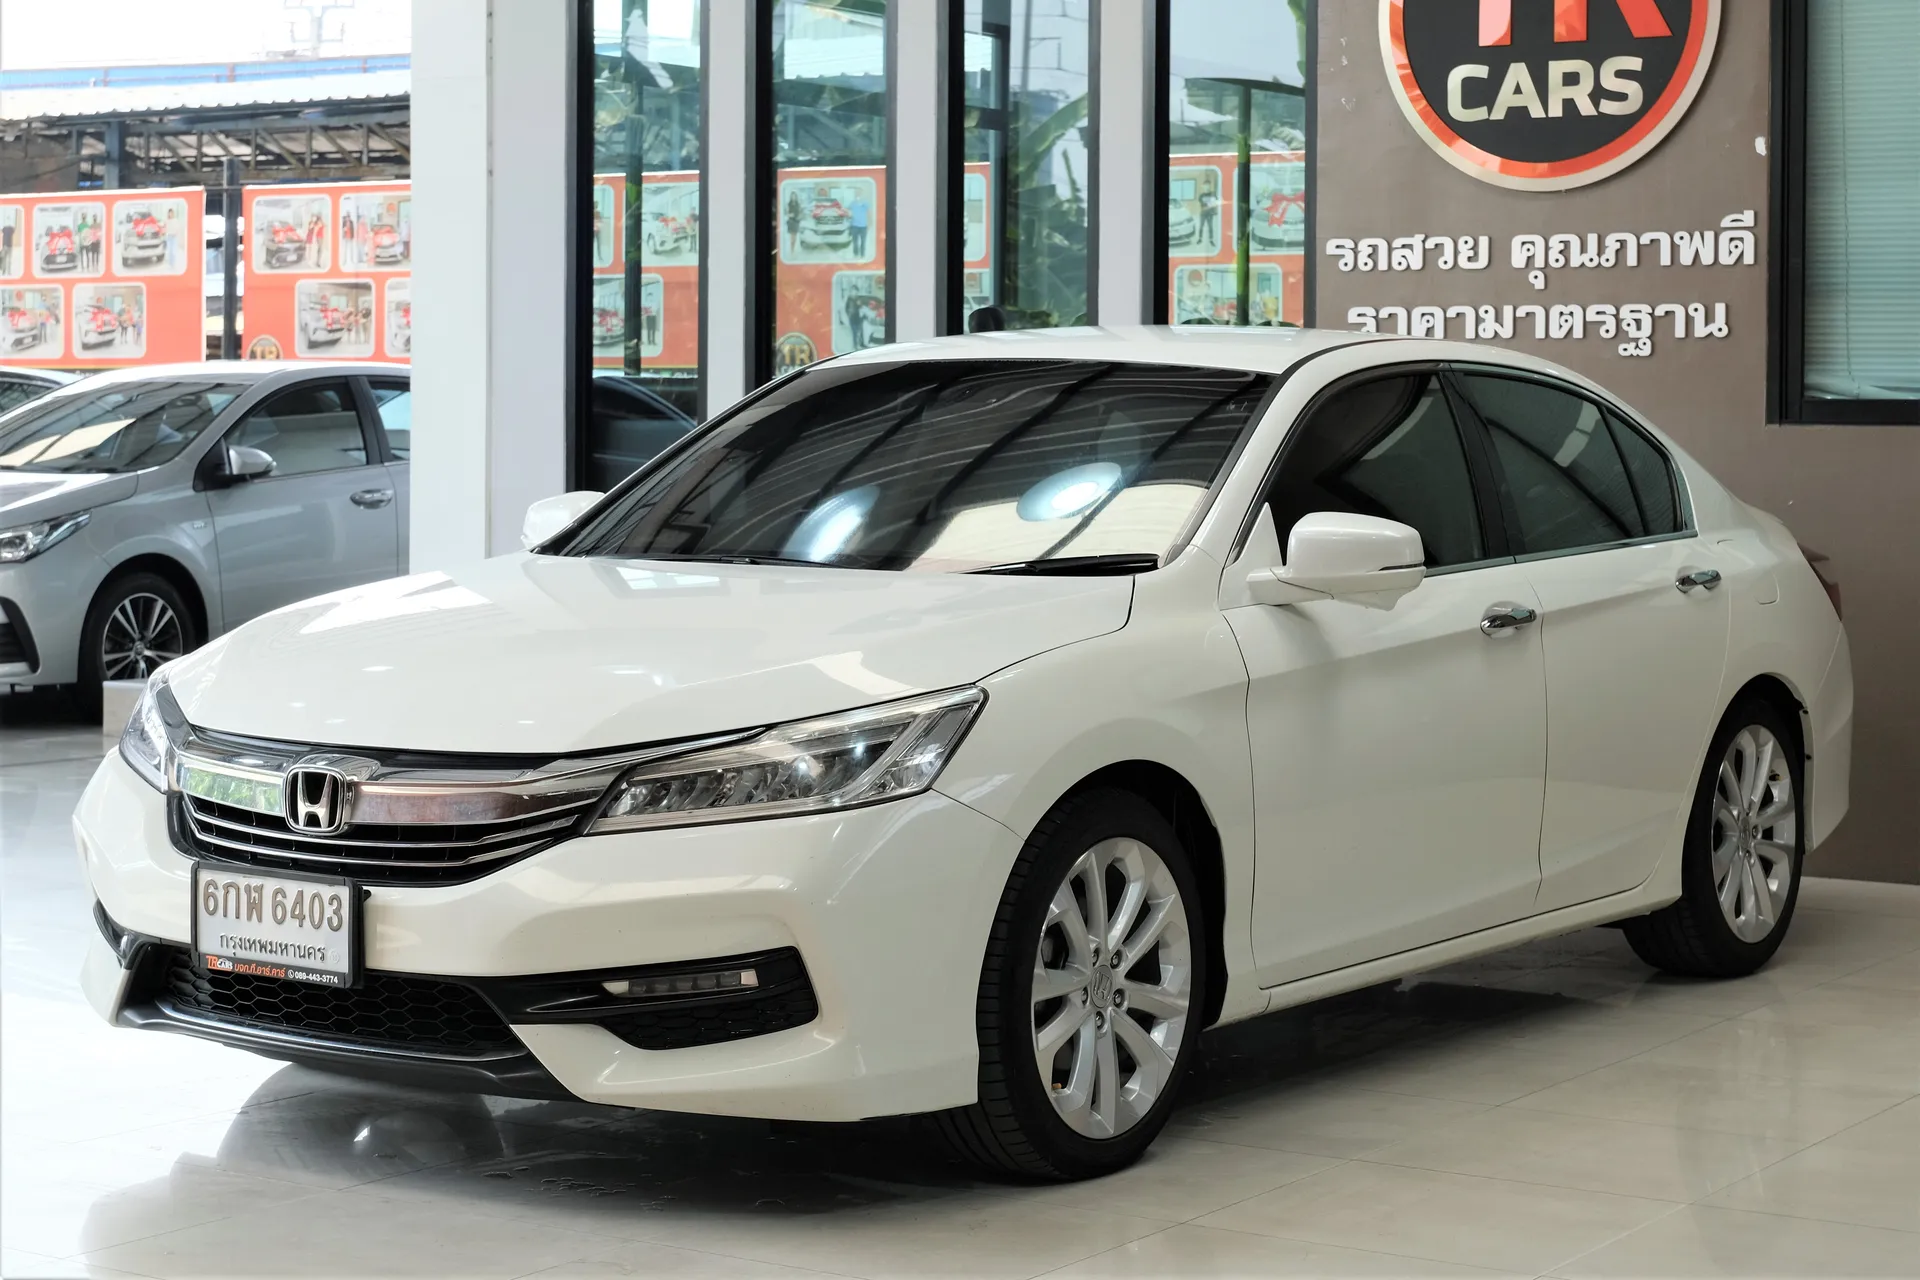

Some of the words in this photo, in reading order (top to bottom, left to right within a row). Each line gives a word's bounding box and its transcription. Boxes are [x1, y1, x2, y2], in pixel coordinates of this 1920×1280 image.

[1447, 56, 1643, 122] CARS
[1326, 233, 1490, 272] รถสวย
[1510, 209, 1756, 290] คุณภาพดี
[1347, 302, 1729, 357] ราคามาตรฐาน
[271, 885, 343, 932] 6403
[219, 933, 326, 962] กรุงเทพมหานคร
